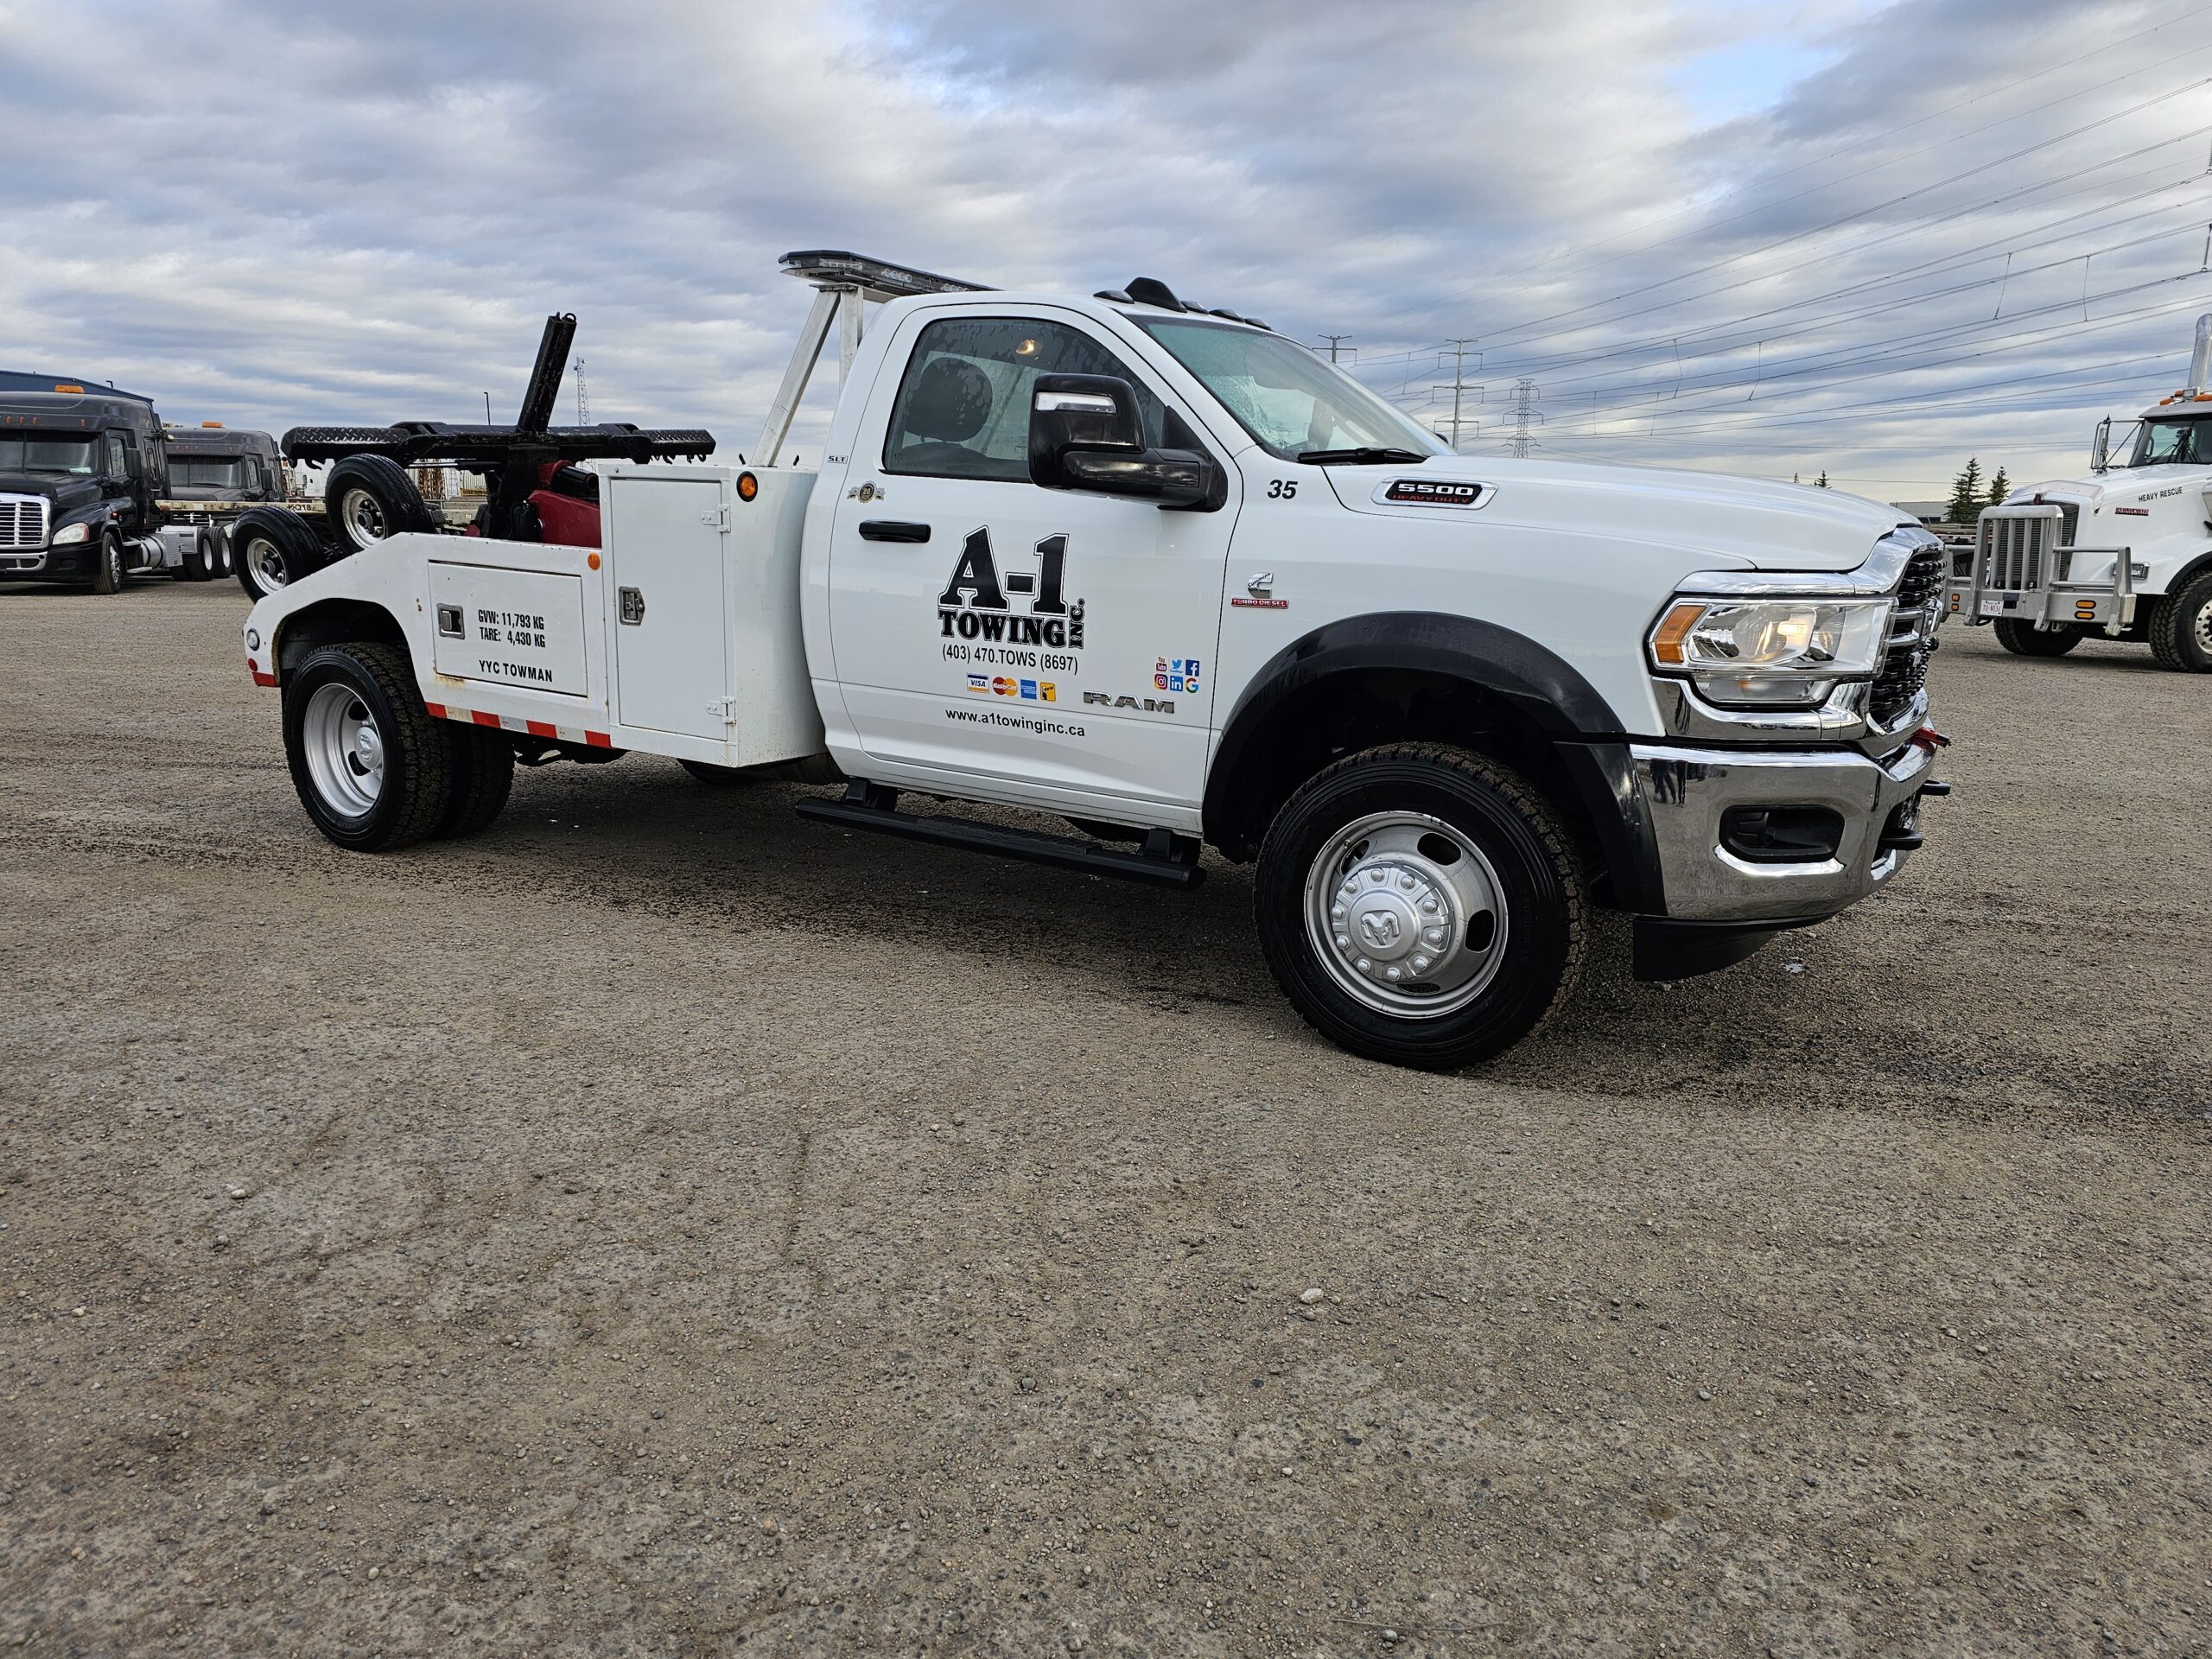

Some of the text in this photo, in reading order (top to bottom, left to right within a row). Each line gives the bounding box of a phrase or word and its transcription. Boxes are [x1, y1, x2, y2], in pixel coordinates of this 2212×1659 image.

[1267, 479, 1298, 499] 35
[1398, 483, 1474, 496] 5500
[2138, 486, 2183, 502] HEAVY RESCUE
[938, 524, 1070, 617] A-1
[1247, 572, 1271, 588] Cummins
[478, 609, 545, 630] GVW: 11,793 KG
[938, 598, 1085, 649] TOWING INC.
[479, 626, 546, 648] TARE: 4,430 KG
[479, 659, 553, 683] YYC TOWMAN
[943, 644, 1078, 676] (403) 470.TOWS (8697)
[970, 679, 987, 688] VISA
[1083, 690, 1175, 714] RAM
[945, 709, 1085, 737] www.a1towinginc.ca
